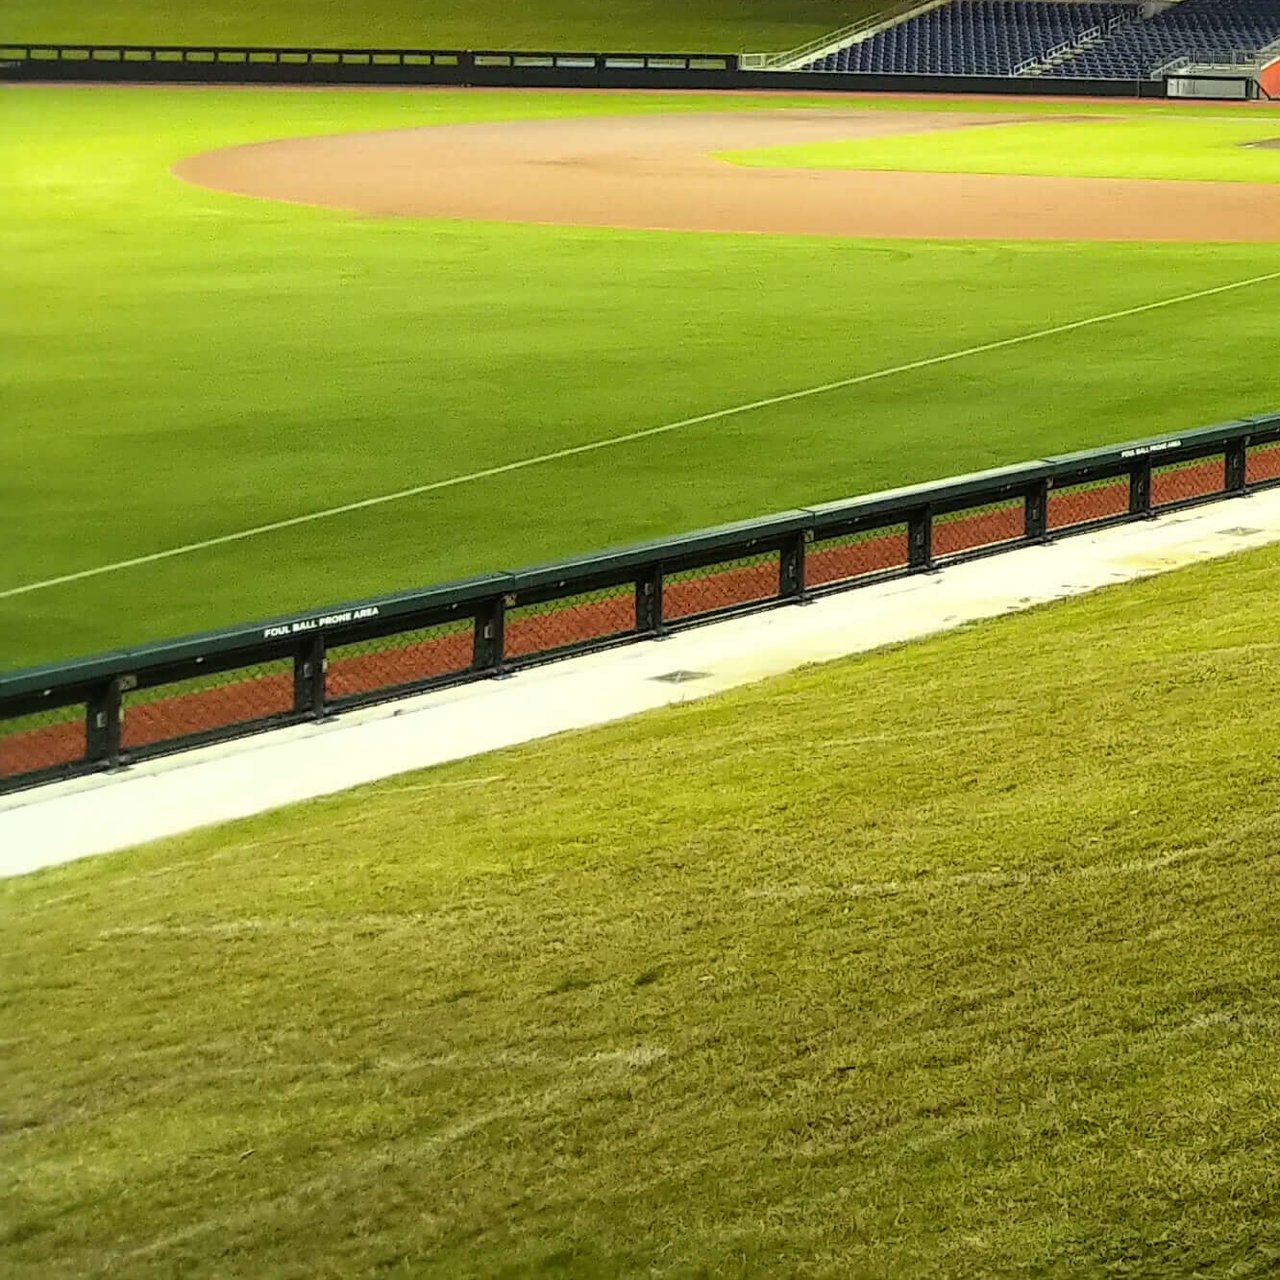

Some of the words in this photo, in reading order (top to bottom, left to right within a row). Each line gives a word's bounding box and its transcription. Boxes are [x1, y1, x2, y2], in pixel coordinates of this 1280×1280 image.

[264, 625, 291, 638] FOUL
[292, 620, 318, 632] BALL
[319, 613, 352, 626] PRONE
[353, 607, 380, 619] AREA
